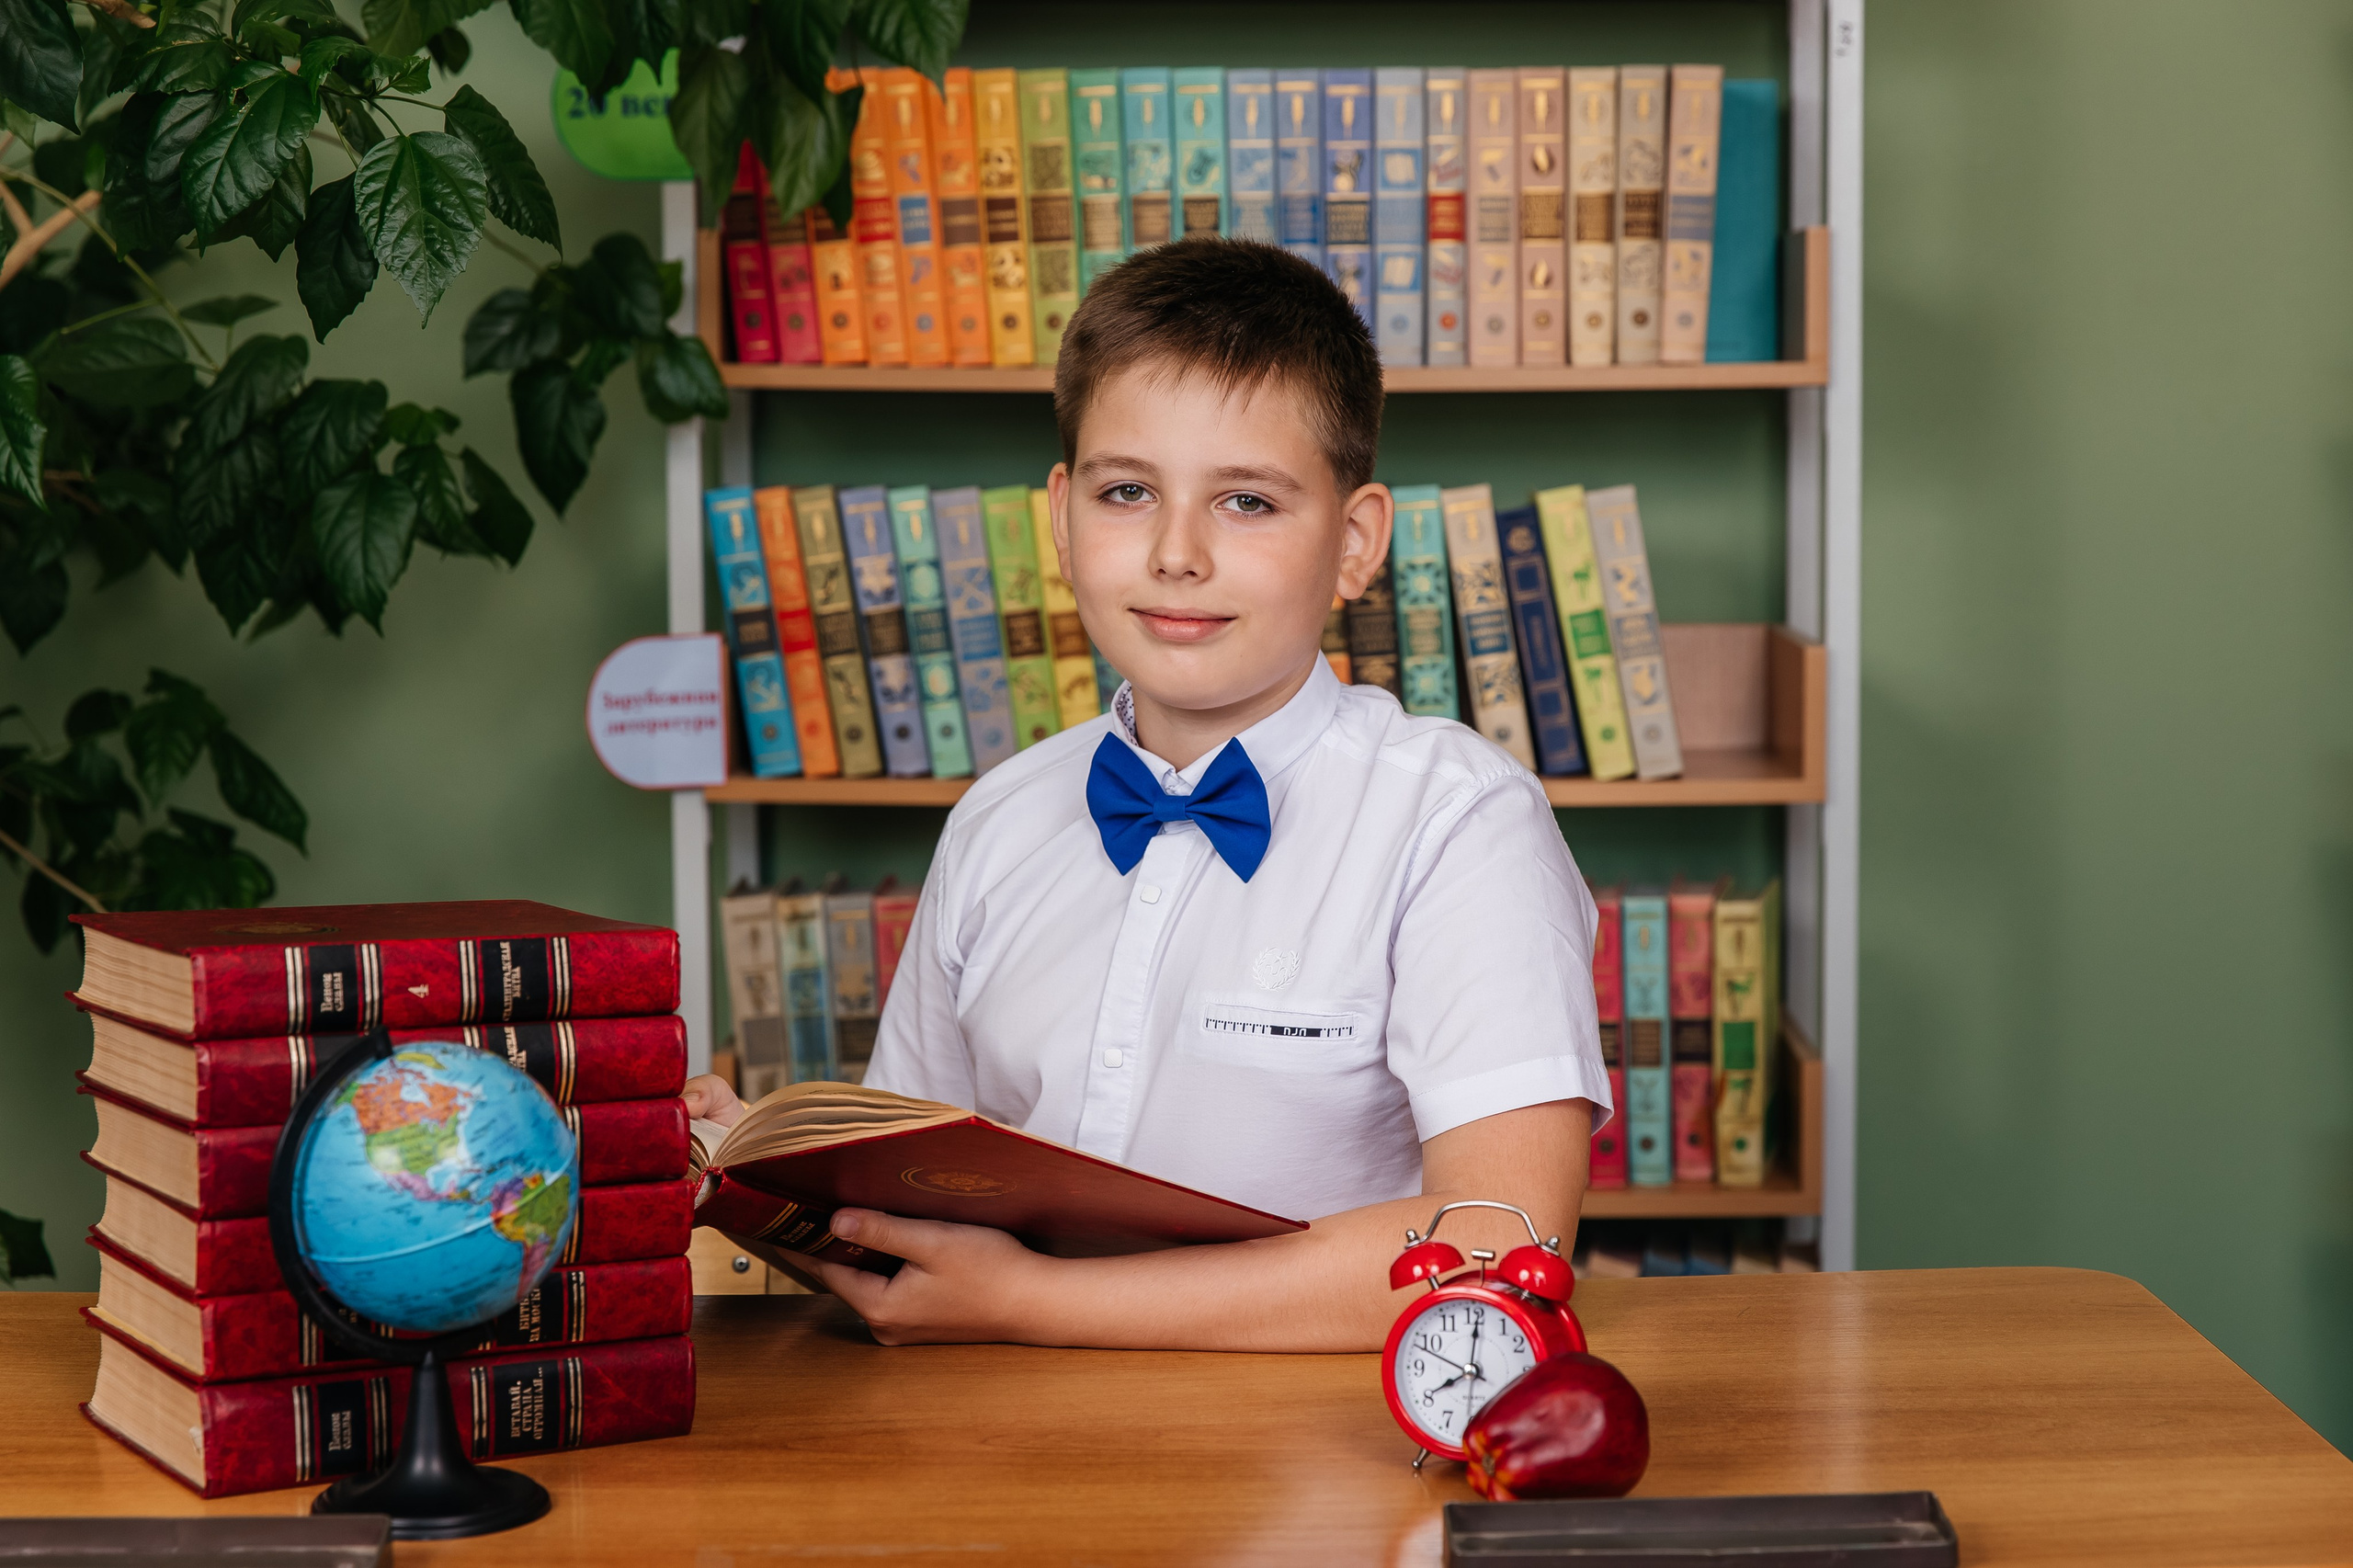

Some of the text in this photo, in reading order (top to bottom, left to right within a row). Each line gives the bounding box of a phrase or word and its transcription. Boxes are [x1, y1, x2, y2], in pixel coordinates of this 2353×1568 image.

[407, 983, 429, 998] 4
[499, 941, 514, 1021] СТАЛИНГРАДСКАЯ
[510, 966, 521, 998] БИТВА
[847, 1244, 864, 1256] 5
[1439, 1314, 1459, 1333] 11
[1462, 1307, 1485, 1325] 12
[1498, 1319, 1510, 1336] 1
[1423, 1334, 1442, 1353] 10
[1513, 1335, 1525, 1354] 2
[1414, 1359, 1425, 1378] 9
[1423, 1390, 1435, 1407] 8
[521, 1387, 533, 1433] СТРАНА
[1442, 1411, 1453, 1428] 7
